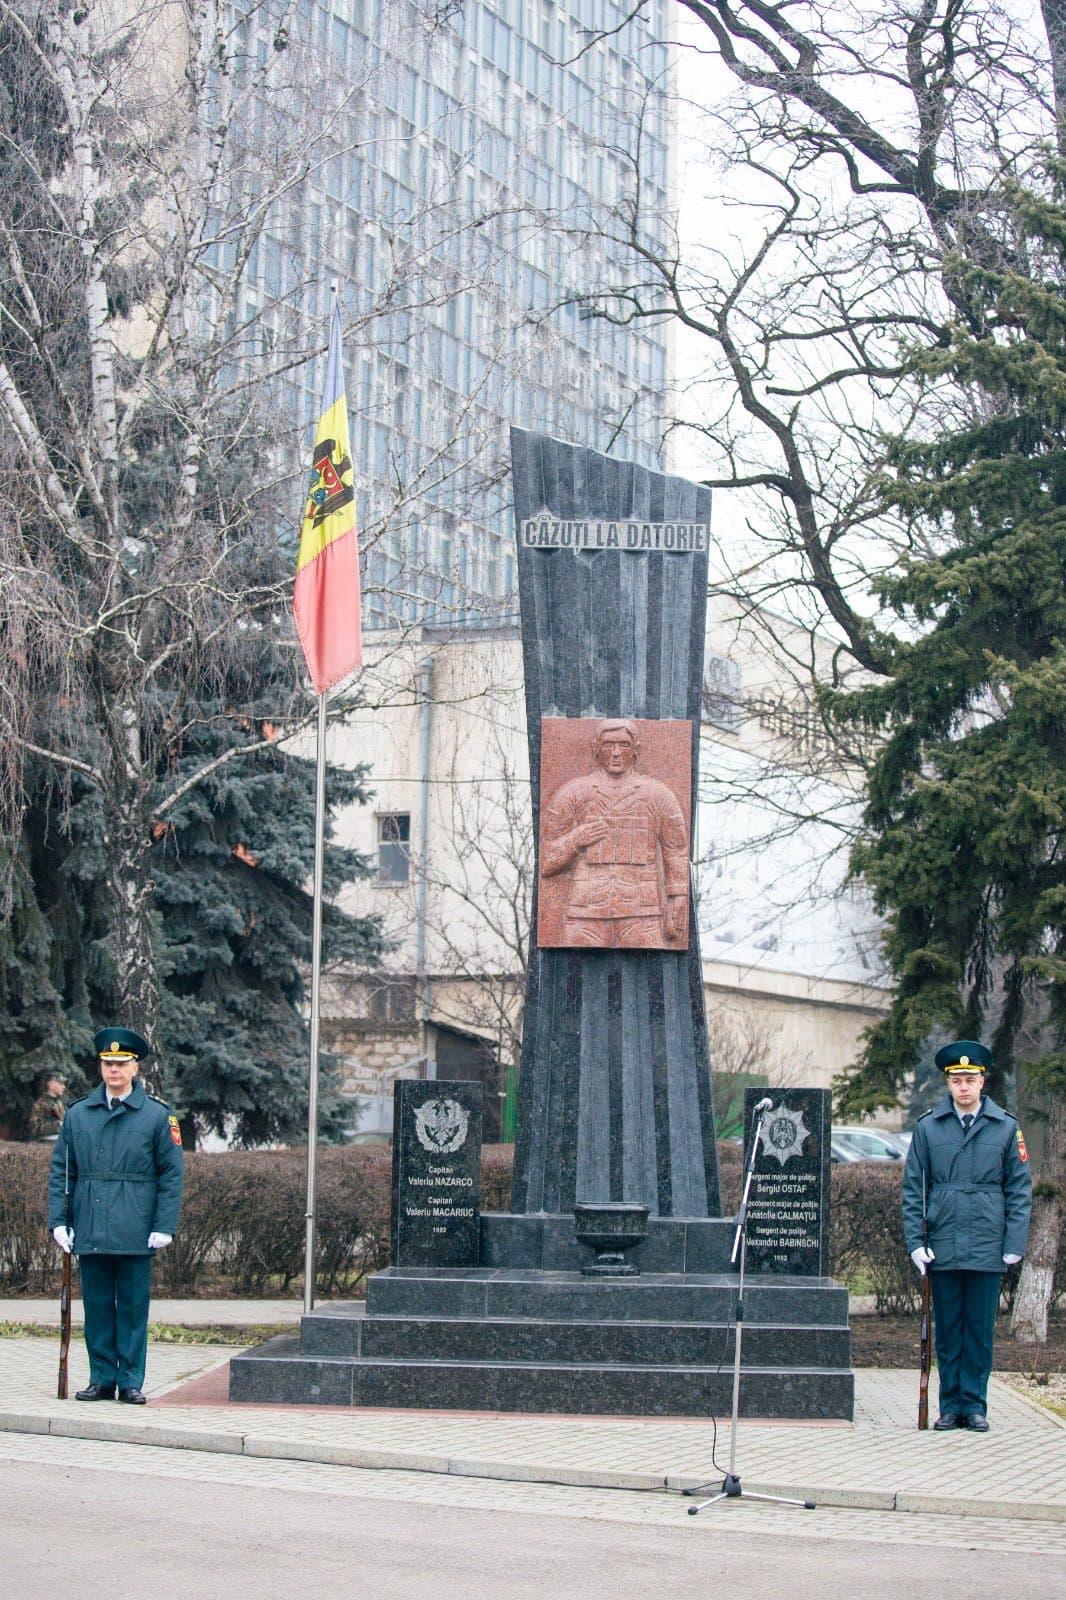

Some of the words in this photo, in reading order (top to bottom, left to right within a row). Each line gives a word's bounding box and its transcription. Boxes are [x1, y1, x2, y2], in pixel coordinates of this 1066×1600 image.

[525, 515, 589, 555] CĂZUȚI
[596, 523, 619, 547] LA
[626, 523, 704, 550] DATORIE
[408, 1176, 434, 1186] Valeriu
[435, 1177, 473, 1187] NAZARCO
[751, 1174, 771, 1182] ergent
[771, 1173, 788, 1182] major
[757, 1183, 780, 1195] Sergiu
[781, 1184, 807, 1193] OSTAF
[747, 1200, 776, 1208] ocotenent
[776, 1200, 793, 1209] major
[406, 1207, 431, 1216] Valeriu
[432, 1207, 474, 1217] MACARIUC
[746, 1210, 776, 1220] Anatolie
[755, 1226, 779, 1236] Sergent
[779, 1238, 819, 1248] BABINSCHI
